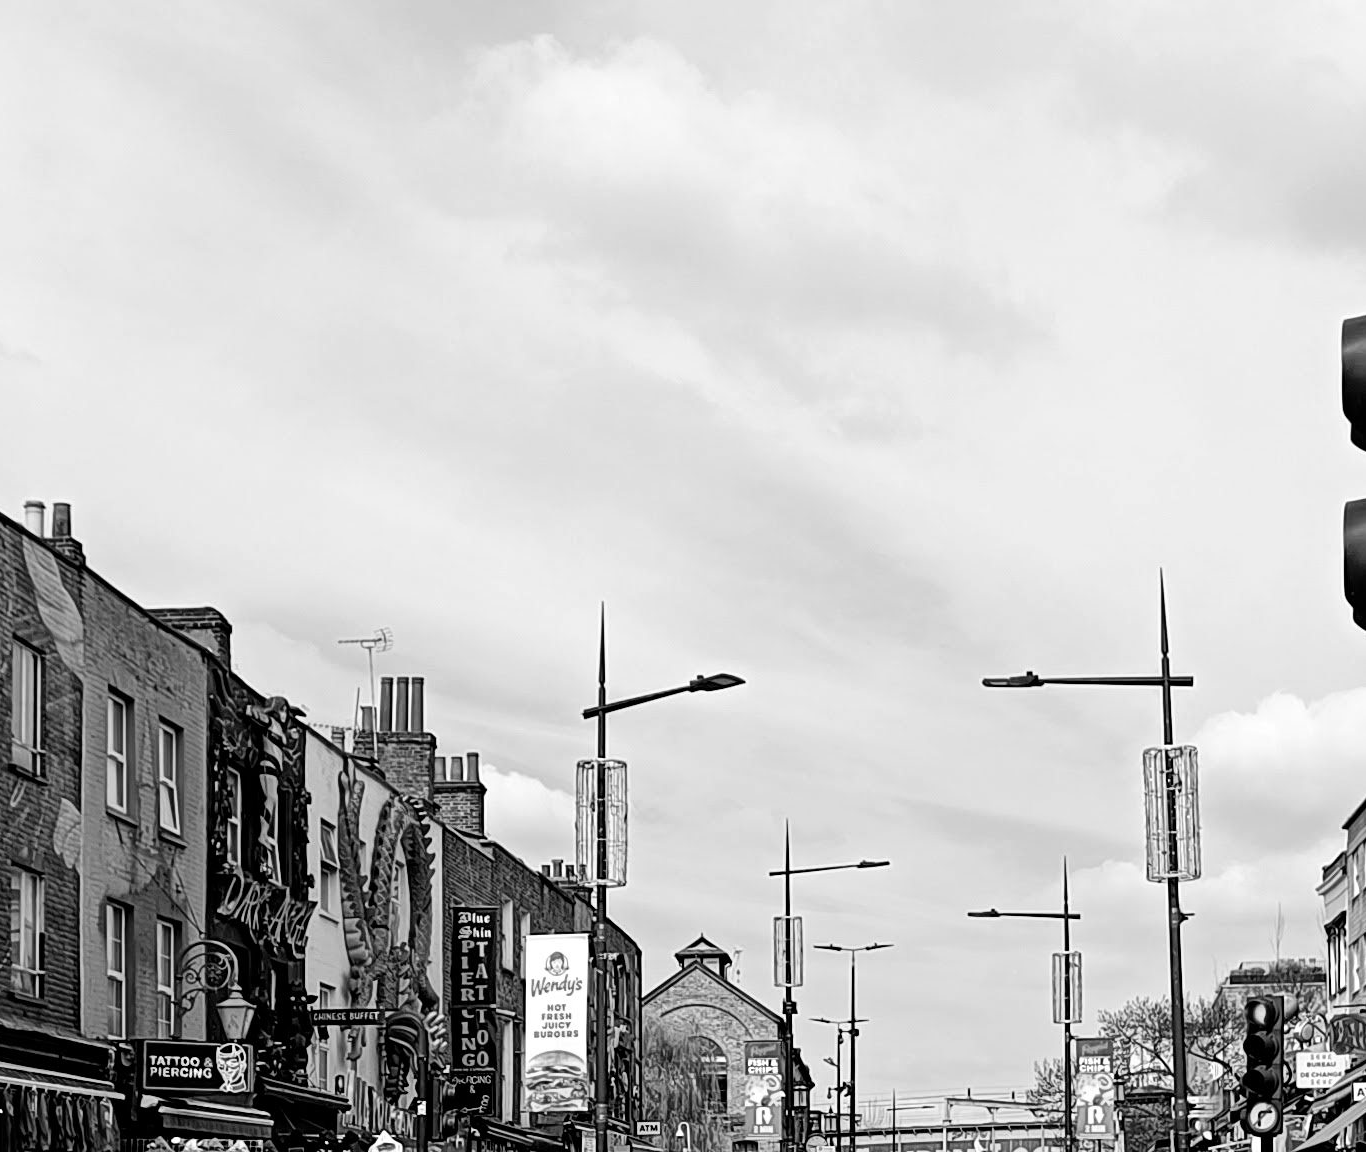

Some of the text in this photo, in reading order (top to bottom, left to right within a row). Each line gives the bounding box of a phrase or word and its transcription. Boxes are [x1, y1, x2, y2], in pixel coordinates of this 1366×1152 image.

[530, 973, 583, 998] Wendy's
[547, 1003, 567, 1012] HOT
[313, 1011, 380, 1021] CHINESE BUFFET
[541, 1012, 572, 1021] FRESH
[541, 1021, 572, 1030] JUICY
[533, 1029, 579, 1039] BURGERS
[149, 1055, 214, 1068] TATTOO &
[748, 1058, 771, 1067] FISH
[1078, 1056, 1102, 1065] FISH
[150, 1066, 213, 1079] PIERCING
[747, 1066, 779, 1075] CHIPS
[1078, 1064, 1111, 1073] CHIPS
[1300, 1071, 1343, 1079] DE CHANGE
[639, 1124, 659, 1132] ATM
